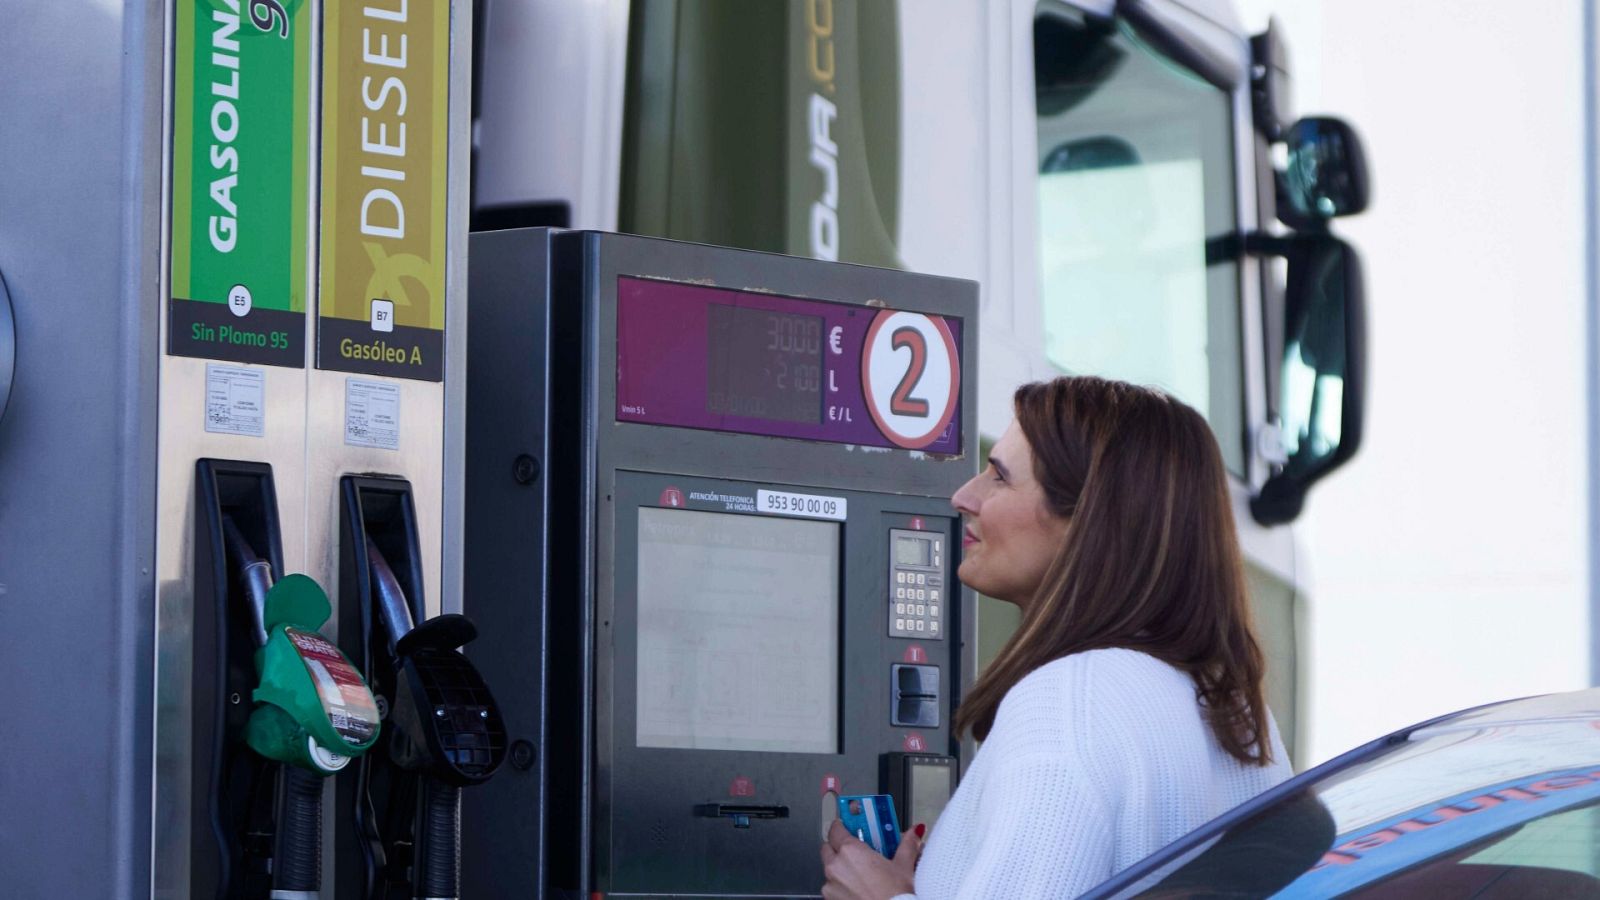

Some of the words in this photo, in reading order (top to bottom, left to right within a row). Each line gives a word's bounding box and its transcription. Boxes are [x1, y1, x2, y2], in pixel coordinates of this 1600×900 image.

[360, 0, 408, 239] DIESEL
[234, 295, 246, 307] E5
[376, 310, 388, 321] B7
[191, 322, 215, 342] Sin
[219, 325, 267, 347] Plomo
[270, 331, 289, 349] 95
[829, 325, 843, 354] €
[340, 338, 406, 363] Gasóleo
[409, 345, 422, 366] A
[829, 369, 839, 392] L
[889, 325, 930, 418] 2
[689, 490, 719, 502] ATENCIÓN
[767, 494, 788, 510] 953
[791, 497, 804, 511] 90
[807, 498, 821, 513] 00
[823, 500, 837, 515] 09
